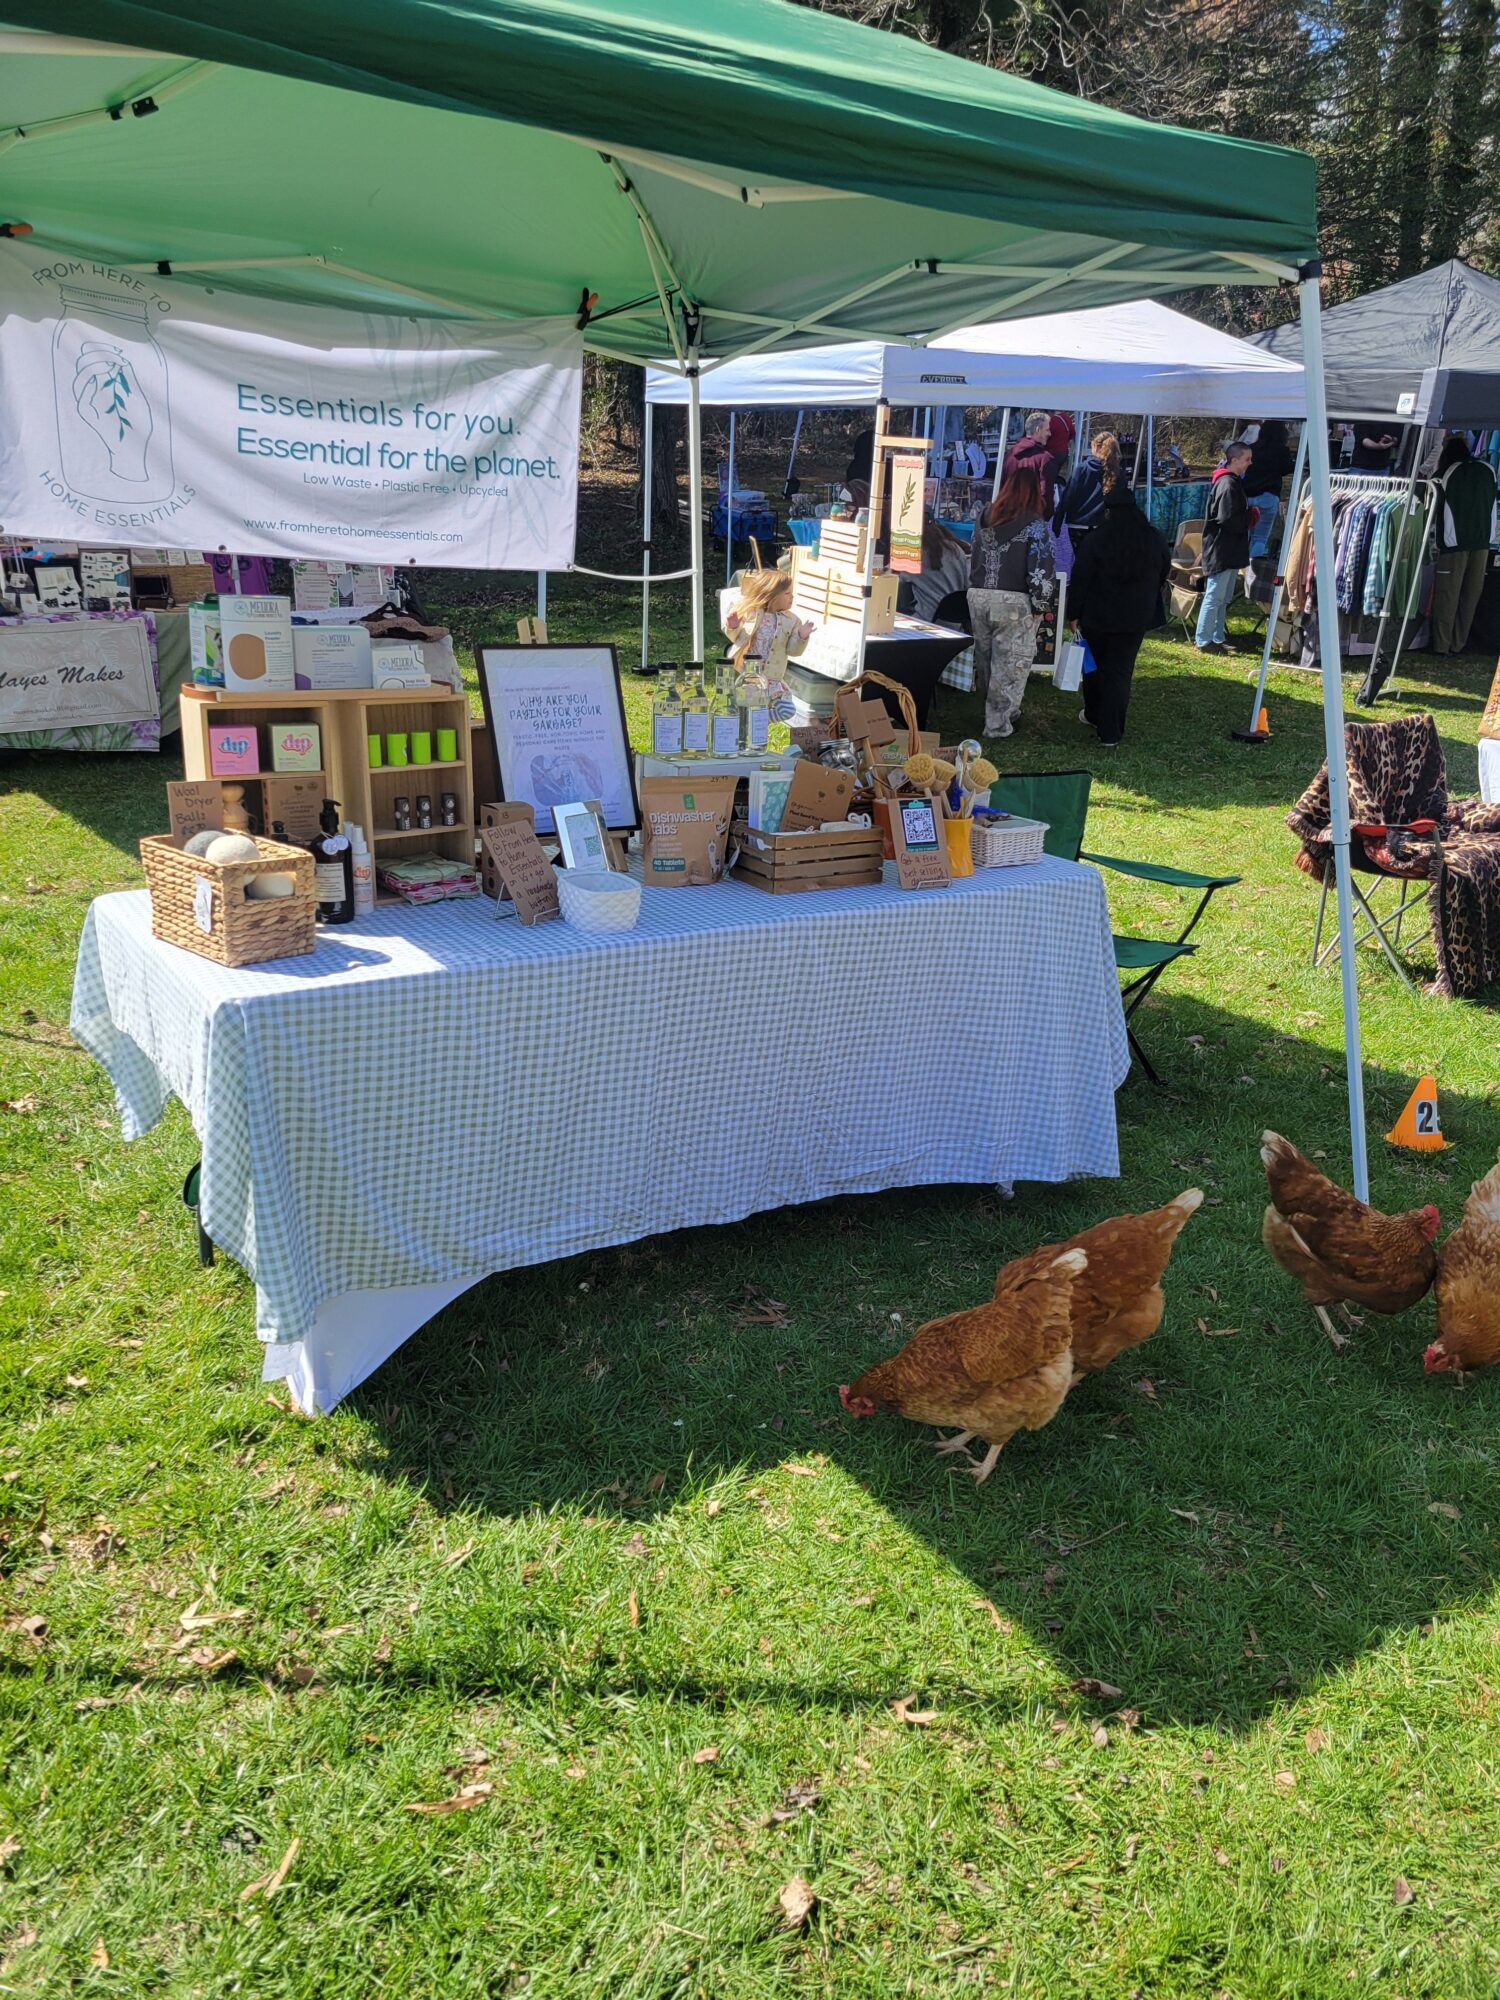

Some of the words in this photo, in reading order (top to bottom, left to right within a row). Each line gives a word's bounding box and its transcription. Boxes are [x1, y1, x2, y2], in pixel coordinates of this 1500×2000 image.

[31, 262, 84, 286] FROM
[92, 263, 145, 293] HERE
[149, 291, 171, 313] TO
[237, 383, 403, 427] Essentials
[411, 403, 456, 432] for
[464, 414, 521, 441] you.
[237, 426, 371, 467] Essential
[377, 442, 417, 470] for
[423, 447, 467, 474] the
[473, 451, 561, 481] planet.
[303, 472, 329, 486] Low
[332, 475, 372, 490] Waste
[381, 479, 421, 493] Plastic
[422, 482, 450, 495] Free
[459, 484, 509, 499] Upcycled
[39, 469, 89, 517] HOME
[94, 484, 197, 528] ESSENTIALS
[243, 519, 464, 543] www.fromheretohomeessentials.com
[57, 665, 126, 684] Makes
[520, 696, 541, 708] WHY
[545, 695, 564, 706] ARE
[568, 694, 588, 706] YOU
[553, 706, 572, 718] FOR
[575, 705, 602, 718] YOUR
[650, 811, 716, 824] Dishwasher
[652, 823, 678, 836] tabs
[487, 825, 517, 842] Follow
[1418, 1102, 1433, 1132] 2
